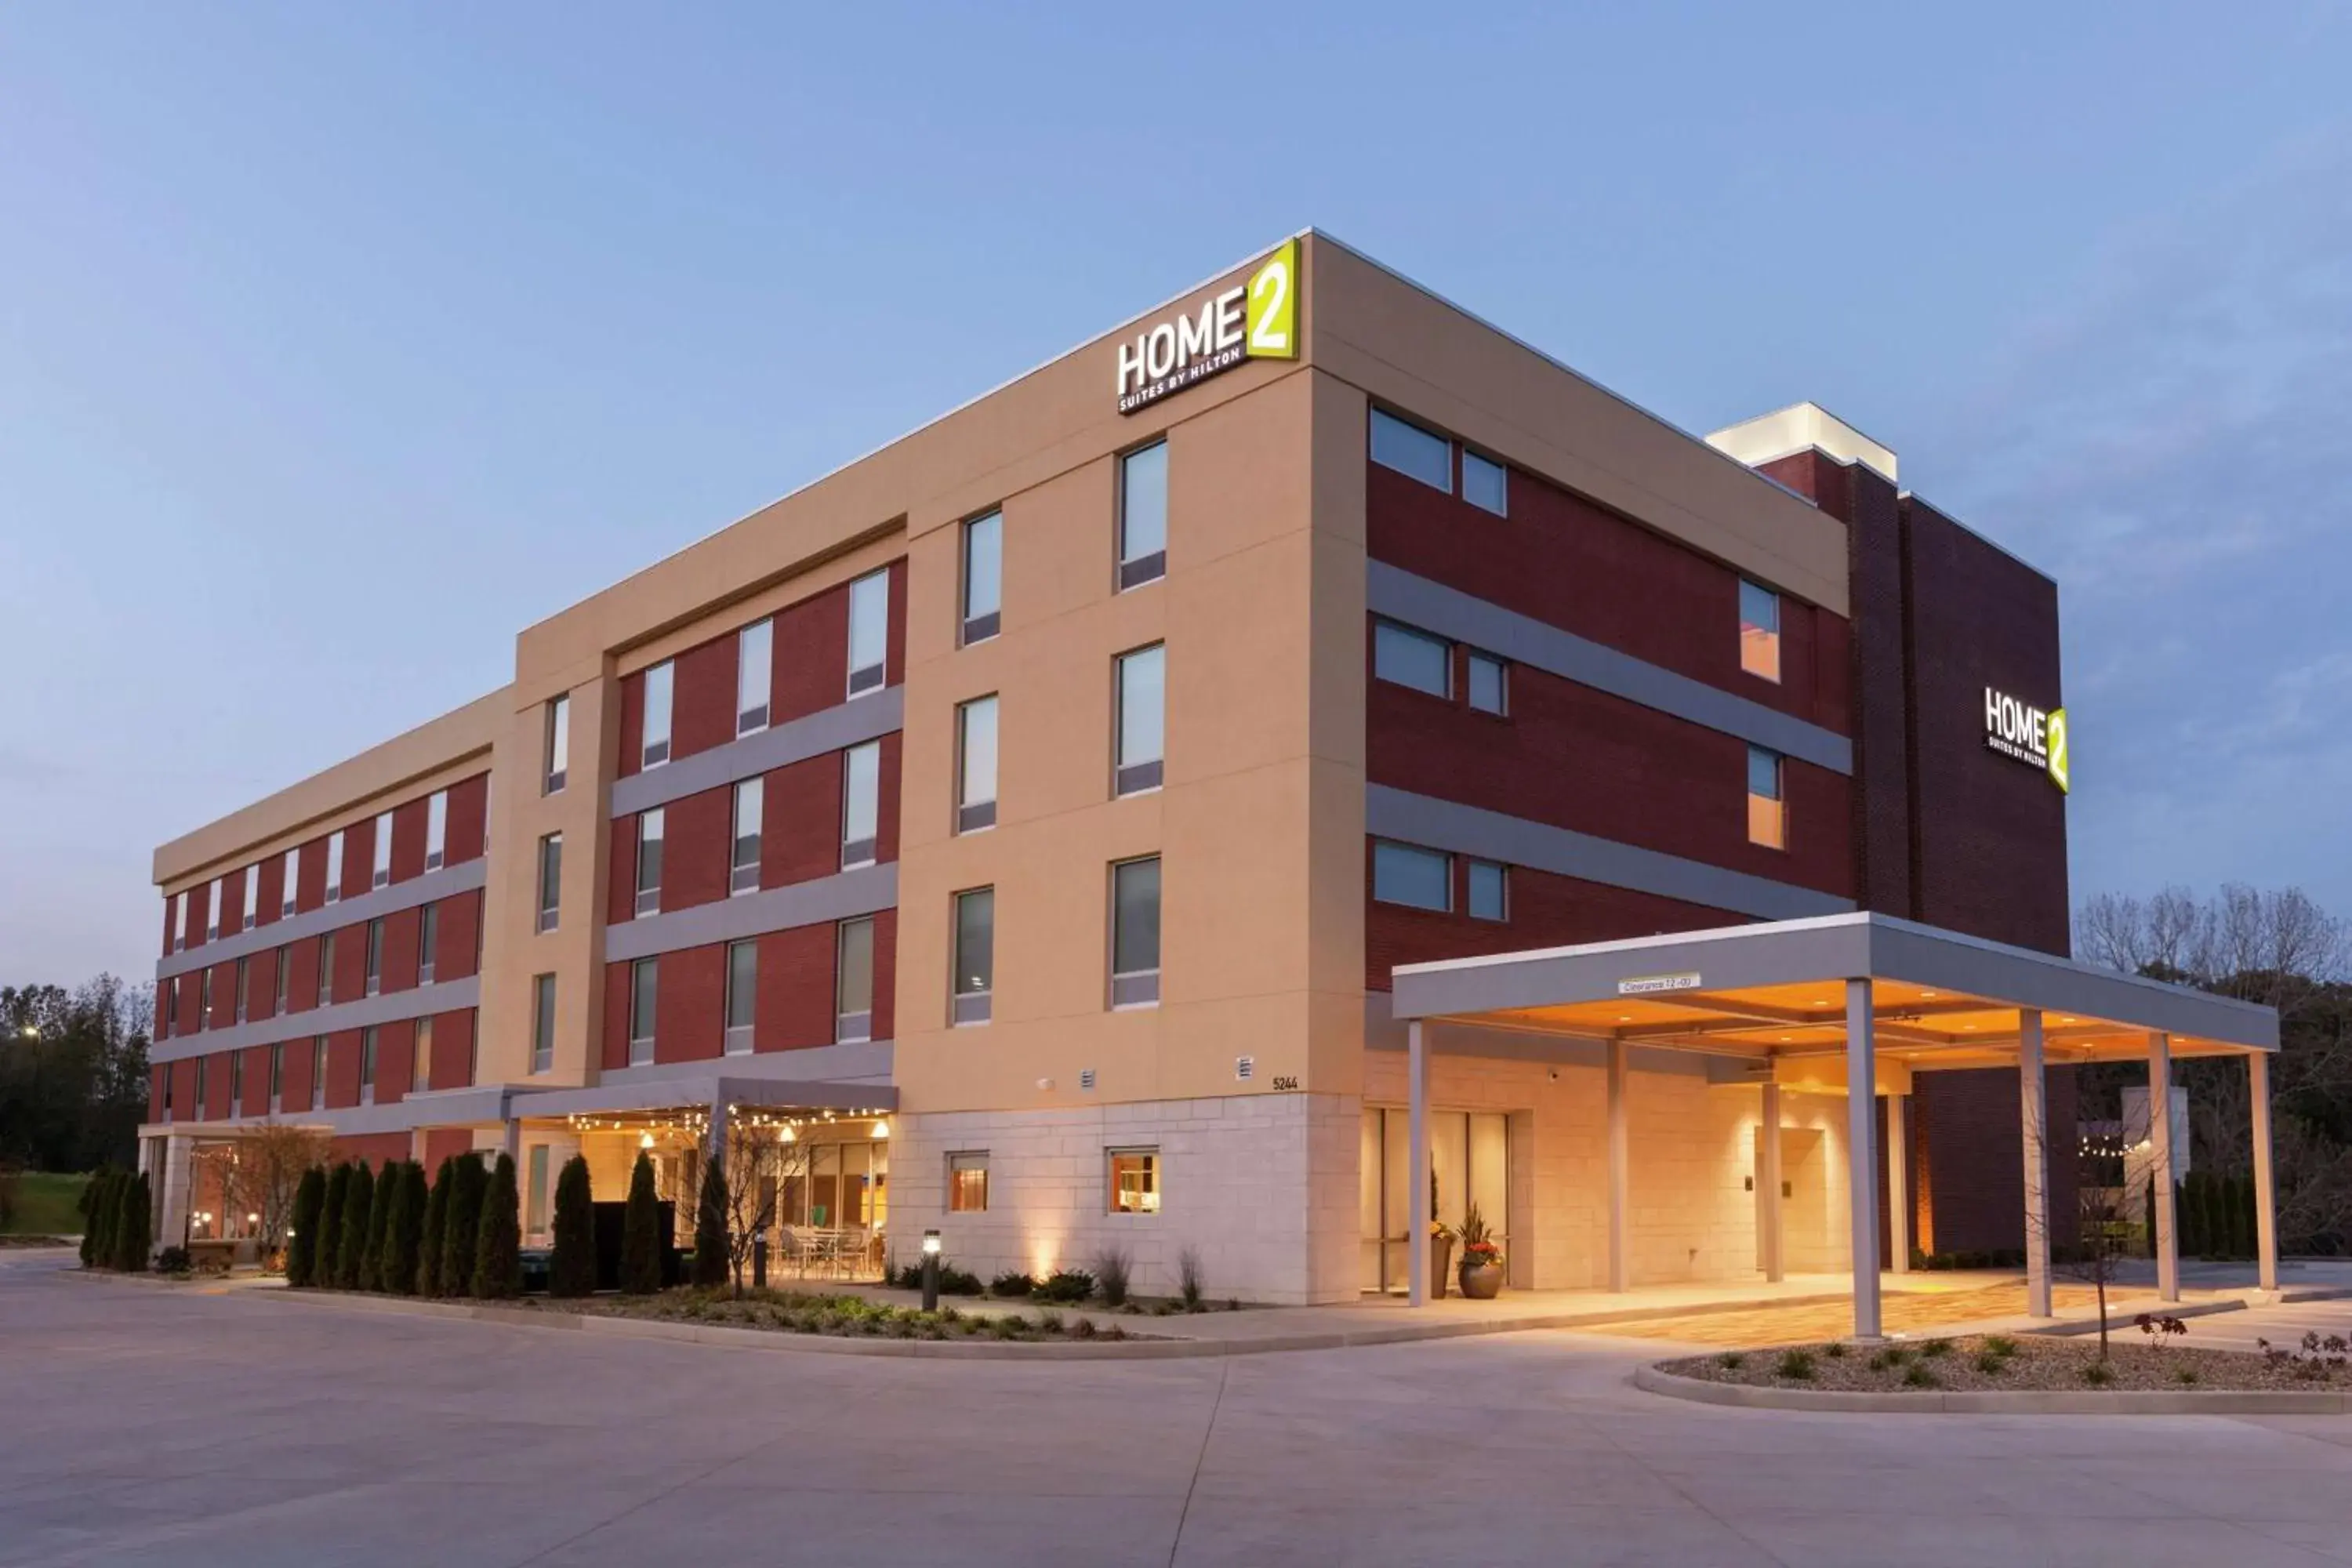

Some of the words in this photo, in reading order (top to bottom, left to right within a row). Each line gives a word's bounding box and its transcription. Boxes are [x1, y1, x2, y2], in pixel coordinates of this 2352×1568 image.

[1117, 285, 1244, 396] HOME
[1252, 262, 1287, 348] 2
[1120, 385, 1163, 411] SUITES
[1169, 376, 1185, 390] BY
[1190, 347, 1240, 379] HILTON
[1985, 687, 2046, 755] HOME
[2049, 717, 2067, 788] 2
[1273, 1076, 1298, 1091] 5244
